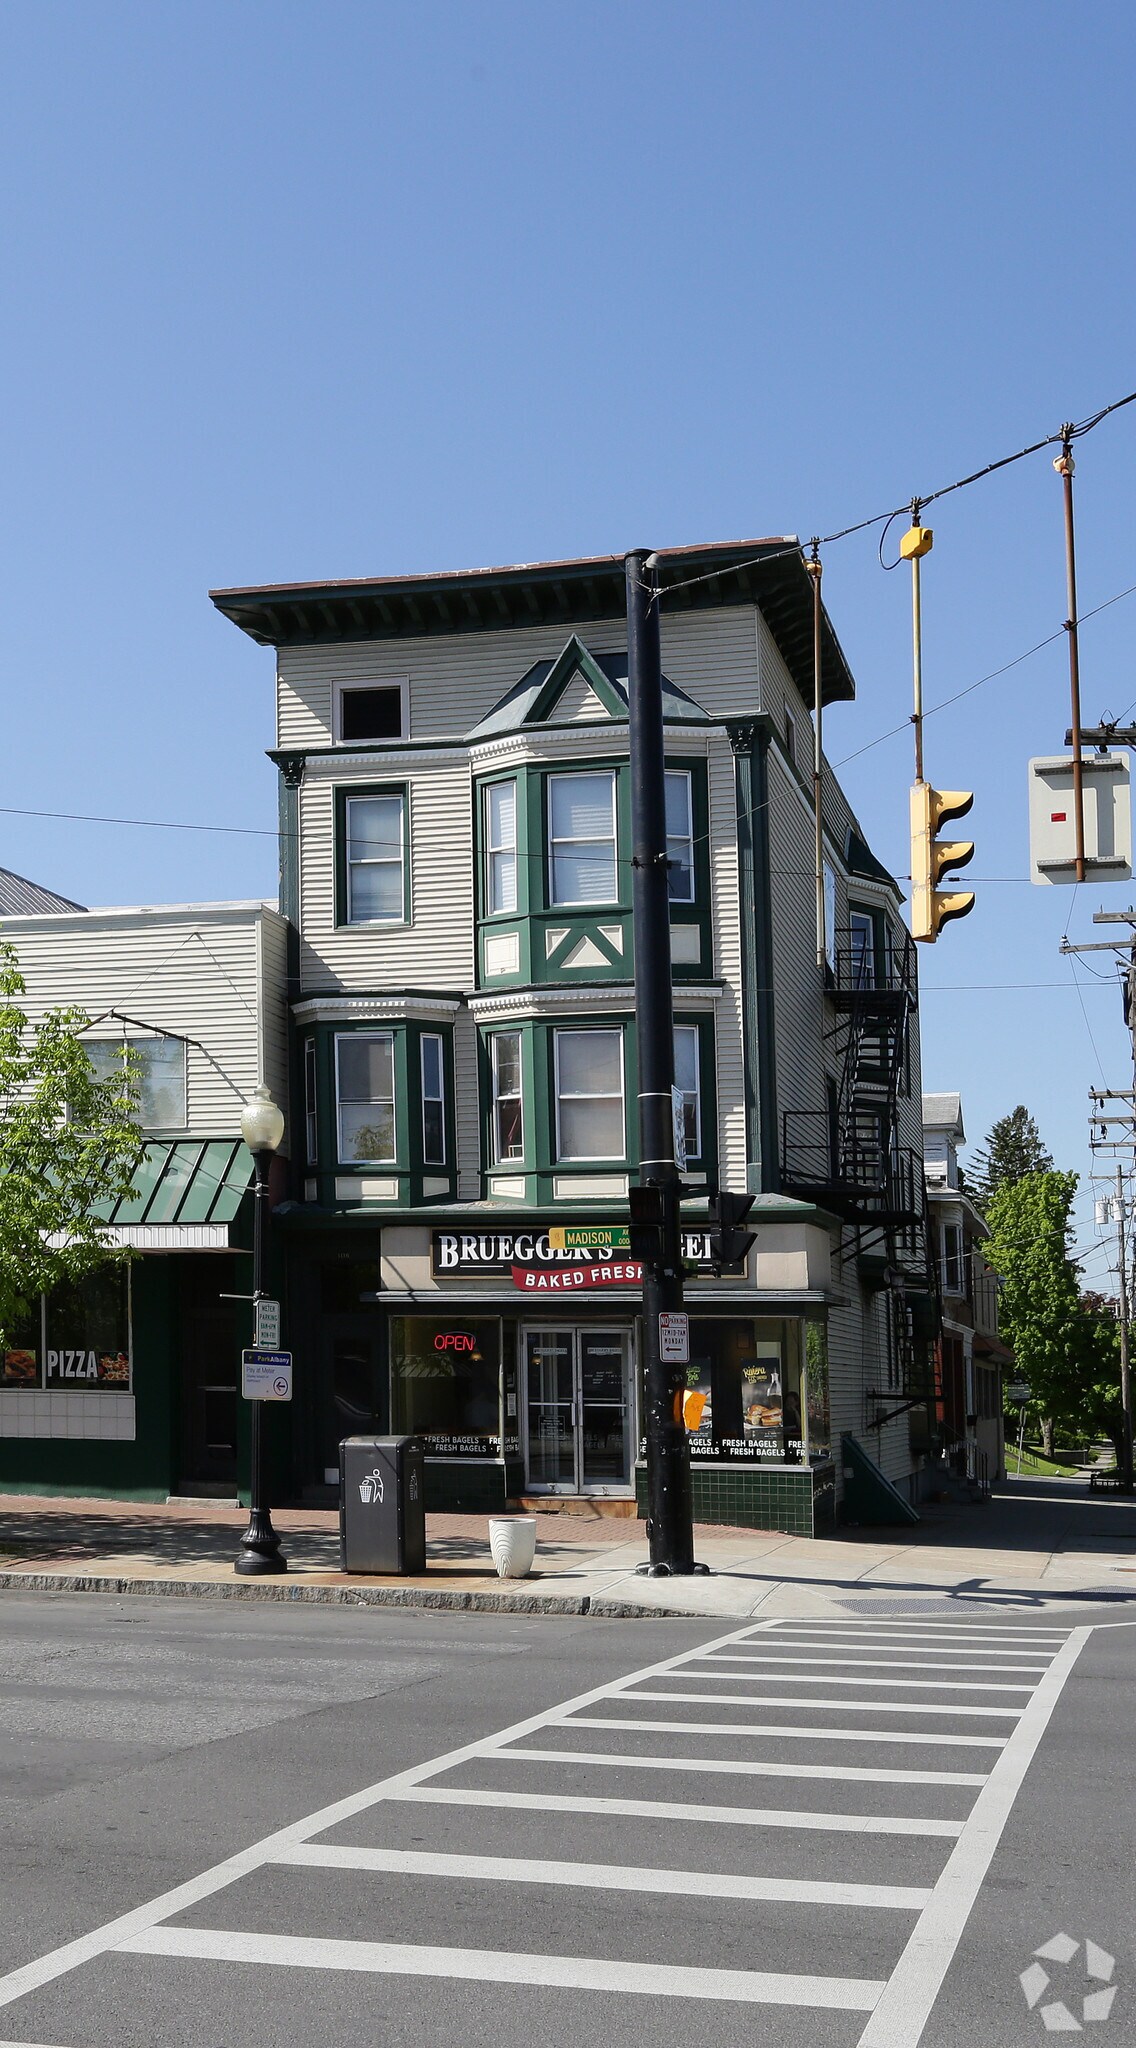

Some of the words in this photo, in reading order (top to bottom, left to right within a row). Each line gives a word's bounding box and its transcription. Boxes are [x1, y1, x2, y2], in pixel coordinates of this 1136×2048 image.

[567, 1232, 612, 1244] MADISON
[439, 1235, 613, 1268] BRUEGG
[525, 1271, 584, 1288] BAKED
[261, 1304, 275, 1312] METER
[259, 1313, 278, 1321] PARKING
[660, 1316, 669, 1326] NO
[434, 1335, 475, 1351] OPEN
[47, 1350, 98, 1378] PIZZA
[428, 1436, 450, 1444] FRESH
[452, 1436, 480, 1444] BAGELS
[688, 1439, 712, 1447] AGELS
[722, 1439, 747, 1448] FRESH
[748, 1440, 778, 1449] BAGELS
[435, 1444, 458, 1452] FRESH
[460, 1445, 487, 1453] BAGELS
[691, 1446, 720, 1455] BAGELS
[730, 1447, 754, 1456] FRESH
[756, 1448, 786, 1457] BAGELS
